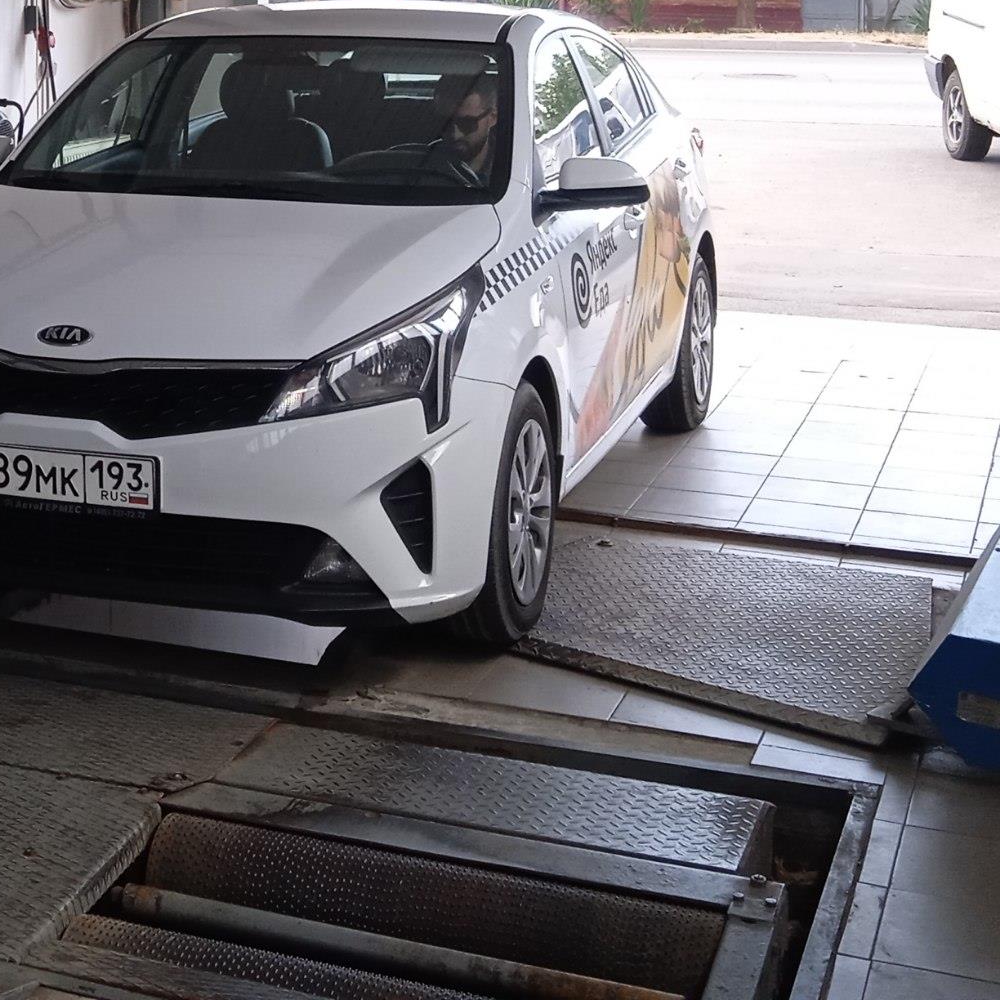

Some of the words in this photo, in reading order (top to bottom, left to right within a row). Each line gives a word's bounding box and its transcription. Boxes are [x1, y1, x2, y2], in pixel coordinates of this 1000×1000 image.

[586, 228, 617, 274] Яндекс
[43, 326, 82, 342] KIA
[90, 460, 143, 492] 193
[101, 490, 128, 502] RUS
